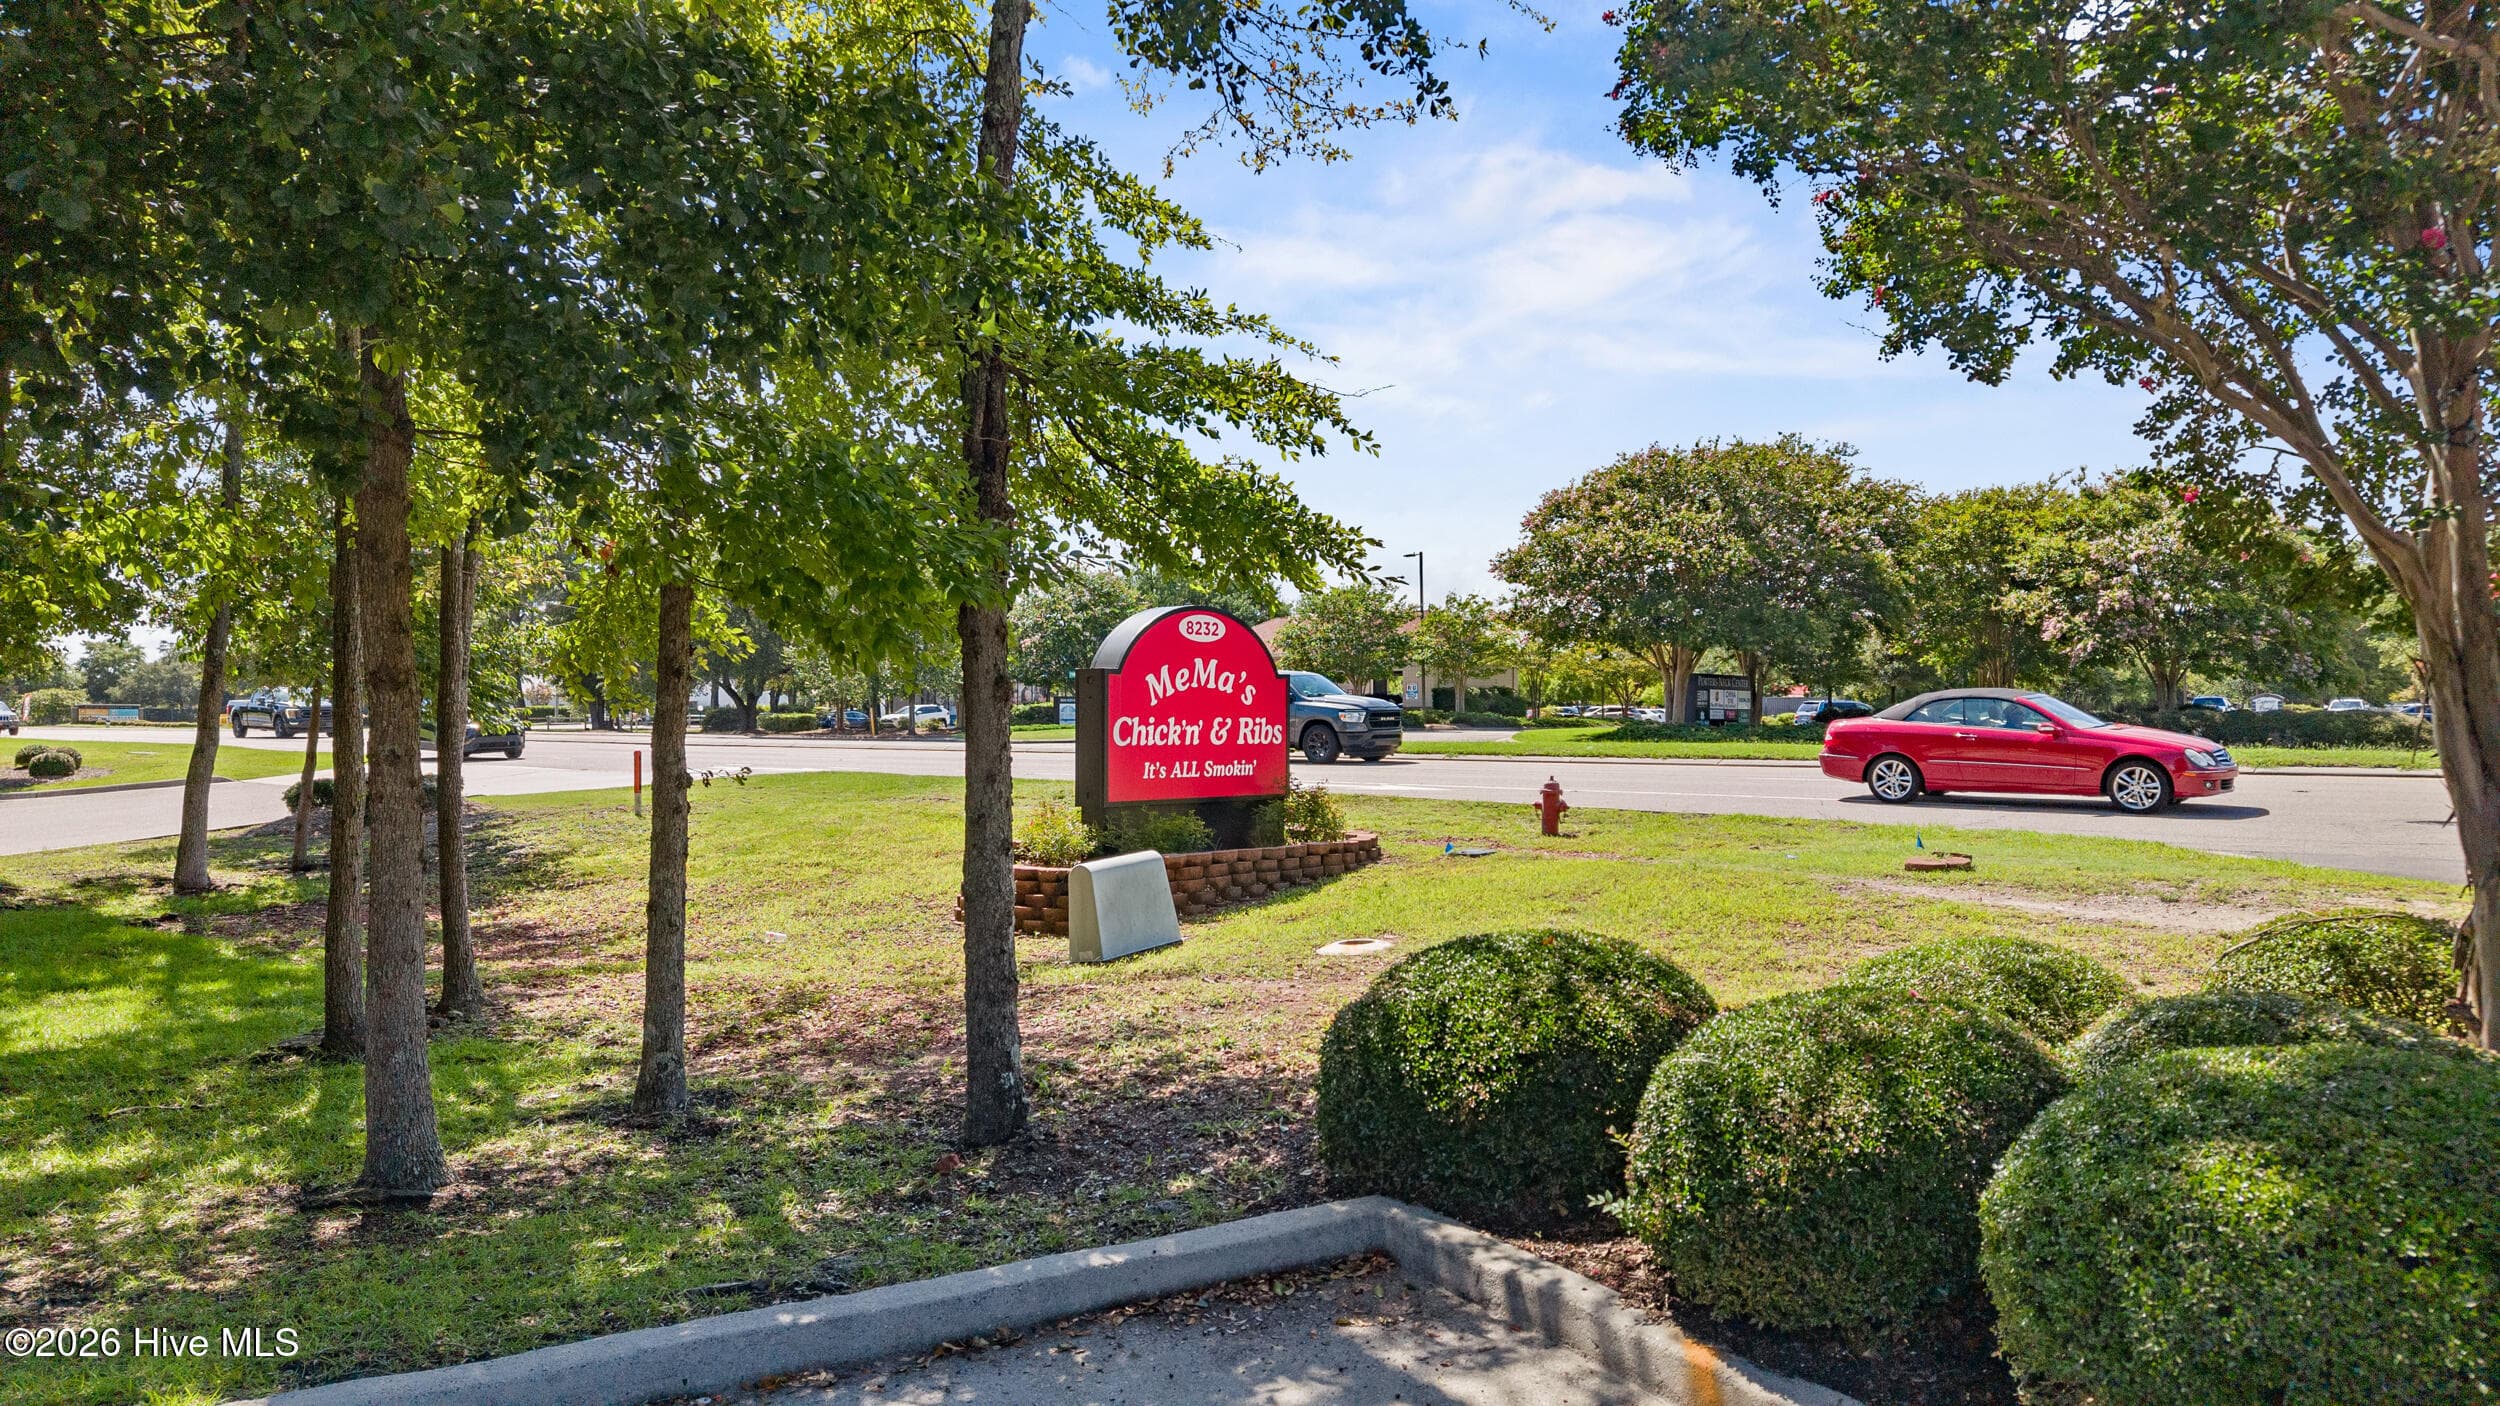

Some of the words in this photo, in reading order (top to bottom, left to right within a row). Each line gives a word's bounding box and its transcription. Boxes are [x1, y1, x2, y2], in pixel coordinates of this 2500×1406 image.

[1185, 620, 1220, 637] 8232
[1145, 657, 1257, 706] MeMa's
[1112, 716, 1203, 747] Chick'n'
[1209, 716, 1232, 746] &
[1236, 716, 1283, 745] Ribs
[1143, 761, 1167, 779] It's
[1170, 760, 1200, 778] ALL
[1203, 760, 1257, 778] Smokin'
